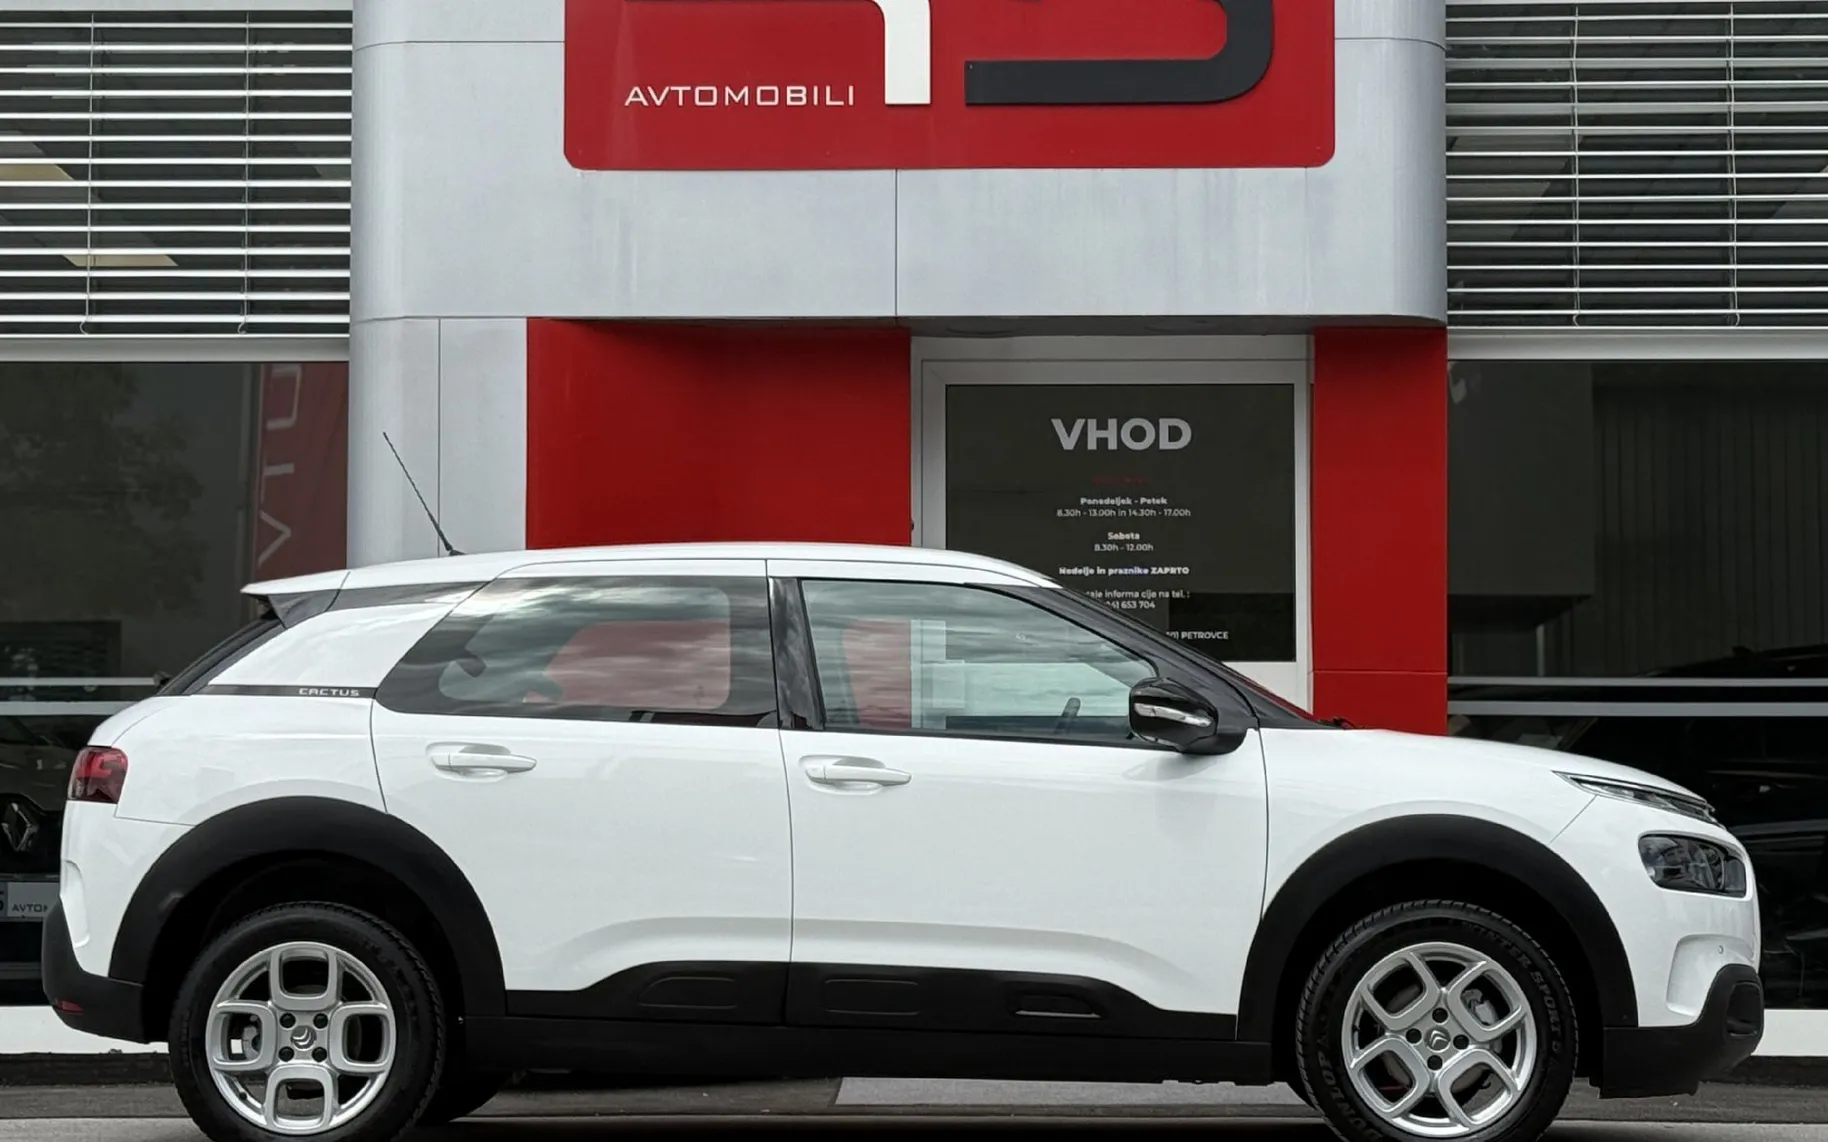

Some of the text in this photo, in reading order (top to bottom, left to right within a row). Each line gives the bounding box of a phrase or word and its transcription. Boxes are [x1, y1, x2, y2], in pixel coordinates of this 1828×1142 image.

[625, 85, 855, 107] AVTOMOBILI
[1051, 418, 1192, 451] VHOD
[1140, 497, 1168, 505] Petek
[1118, 508, 1126, 517] in
[1108, 532, 1140, 540] Sobota
[1097, 566, 1106, 575] in
[1150, 566, 1190, 575] ZAPRTO
[1121, 600, 1137, 609] 653
[1139, 600, 1156, 609] 704
[1181, 631, 1229, 640] PETROVCE
[299, 688, 360, 697] CACTUS
